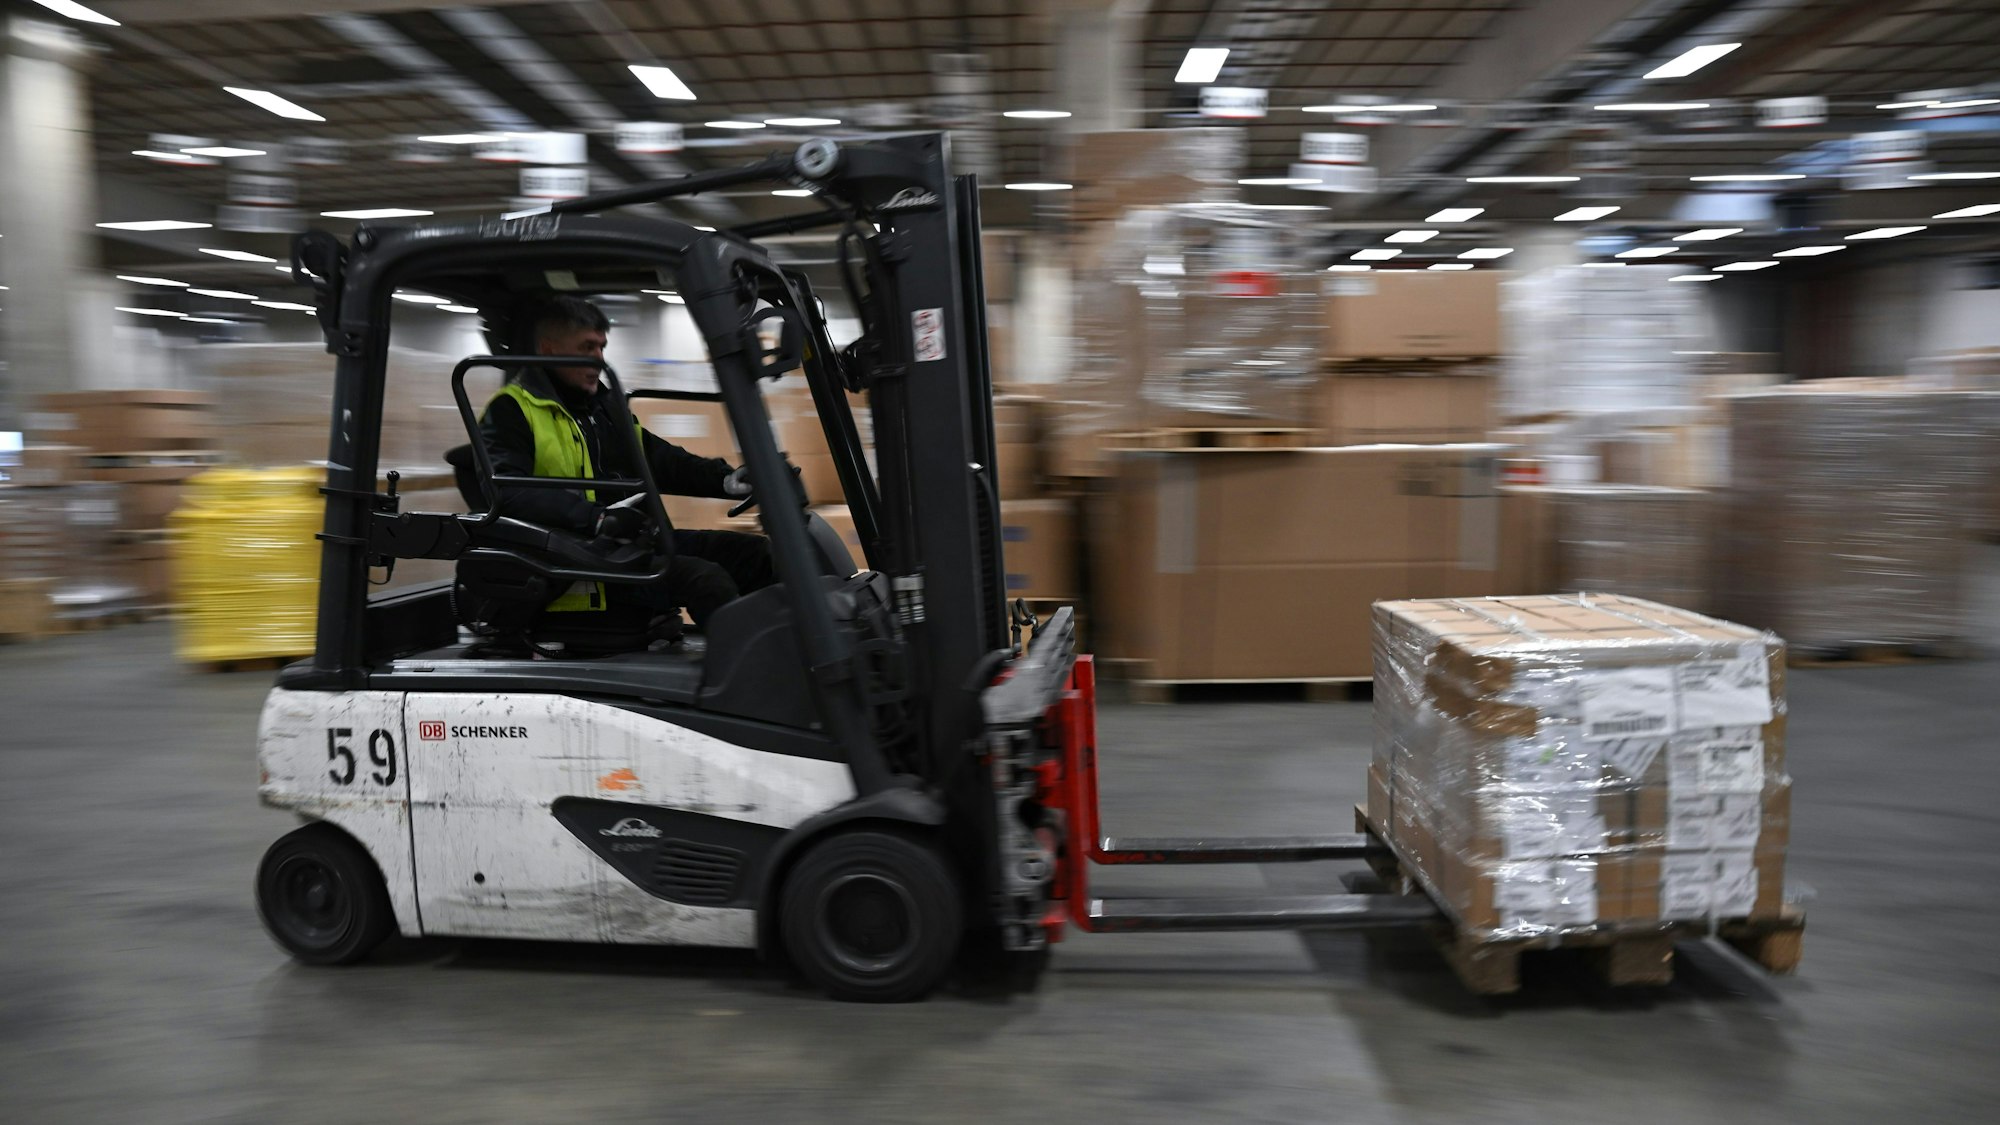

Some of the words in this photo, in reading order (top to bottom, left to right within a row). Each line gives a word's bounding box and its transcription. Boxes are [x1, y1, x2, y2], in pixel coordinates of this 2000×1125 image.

[421, 724, 444, 738] DB
[451, 726, 528, 738] SCHENKER
[327, 728, 397, 787] 59
